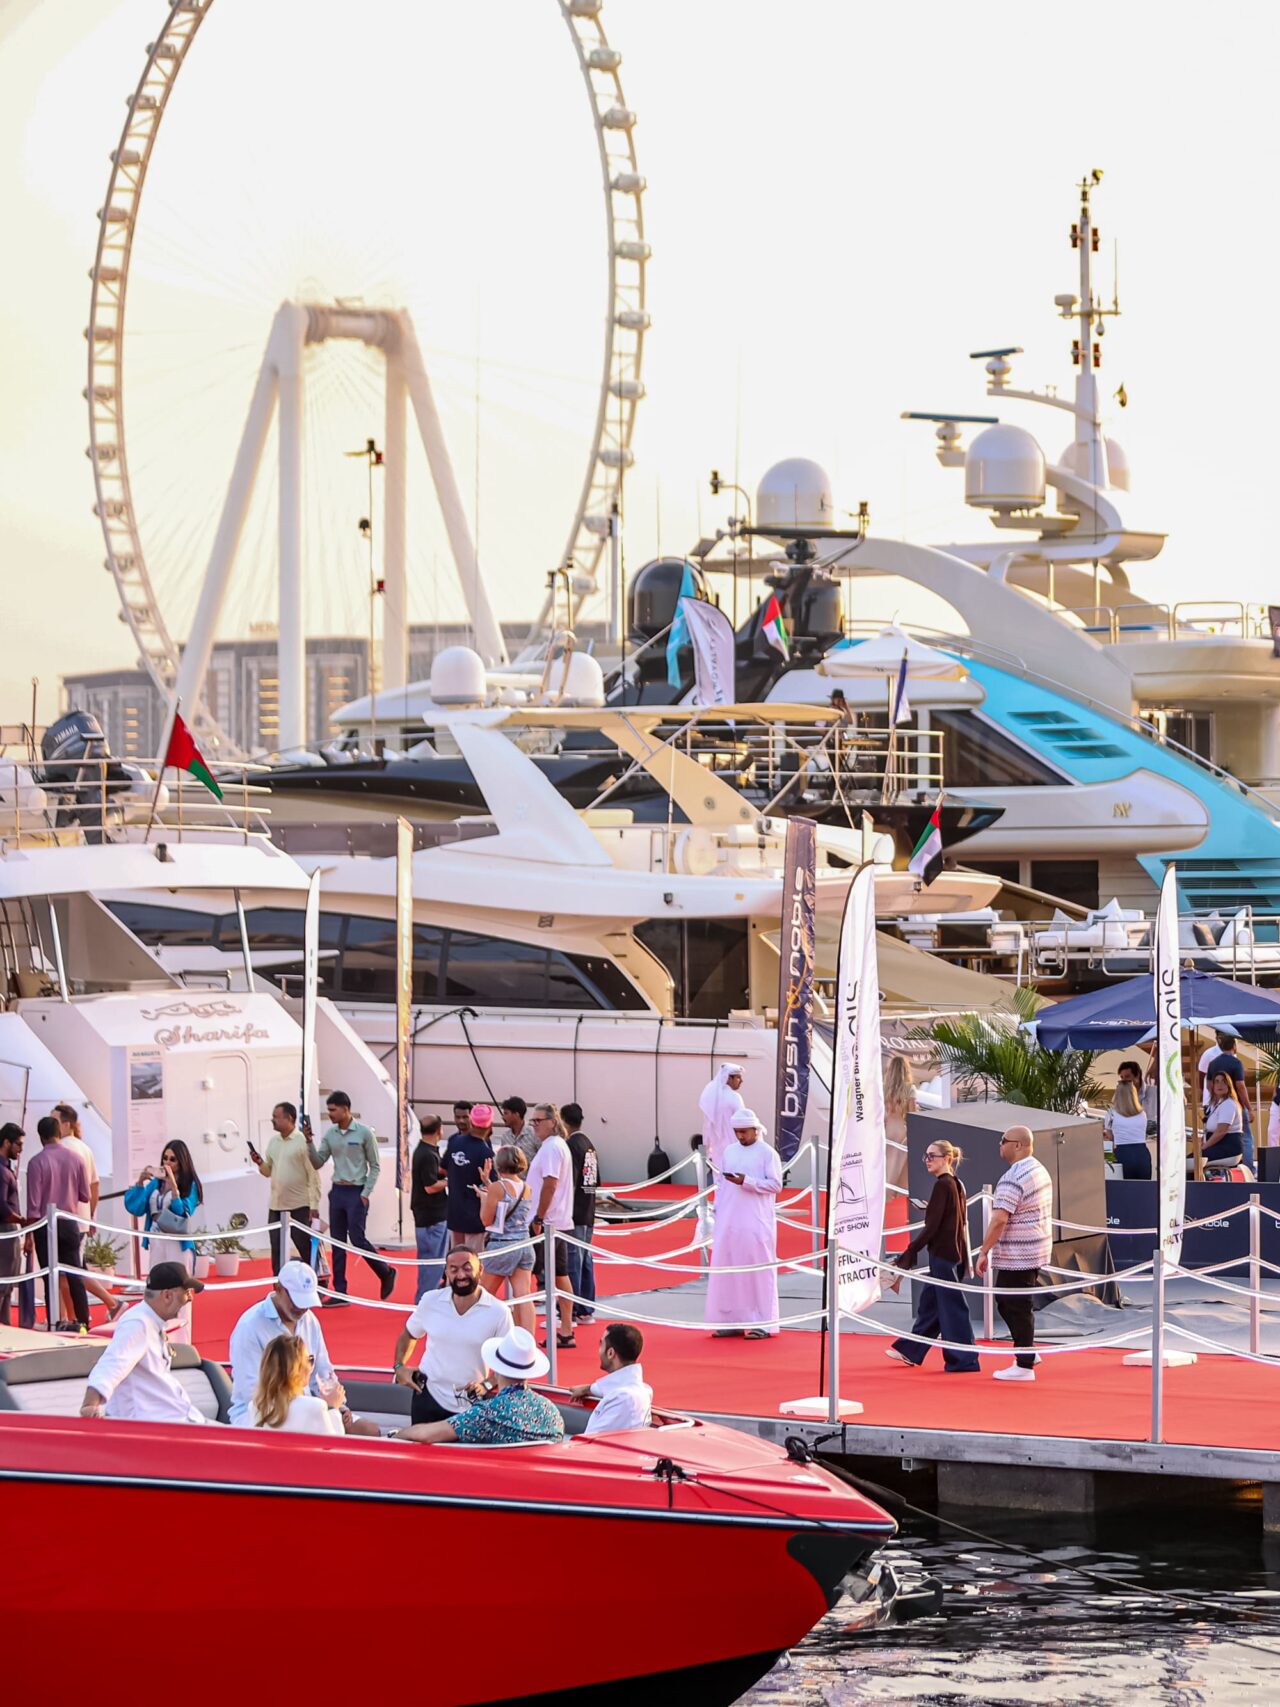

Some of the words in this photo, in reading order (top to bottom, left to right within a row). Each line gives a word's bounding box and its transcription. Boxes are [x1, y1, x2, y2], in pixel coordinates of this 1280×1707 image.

[54, 724, 79, 745] YAMAHA
[789, 866, 805, 976] noble
[154, 1022, 269, 1050] Sharifa
[780, 1018, 799, 1117] bush
[854, 1077, 865, 1122] Waagner
[833, 1226, 845, 1236] OAT
[847, 1222, 869, 1232] SHOW
